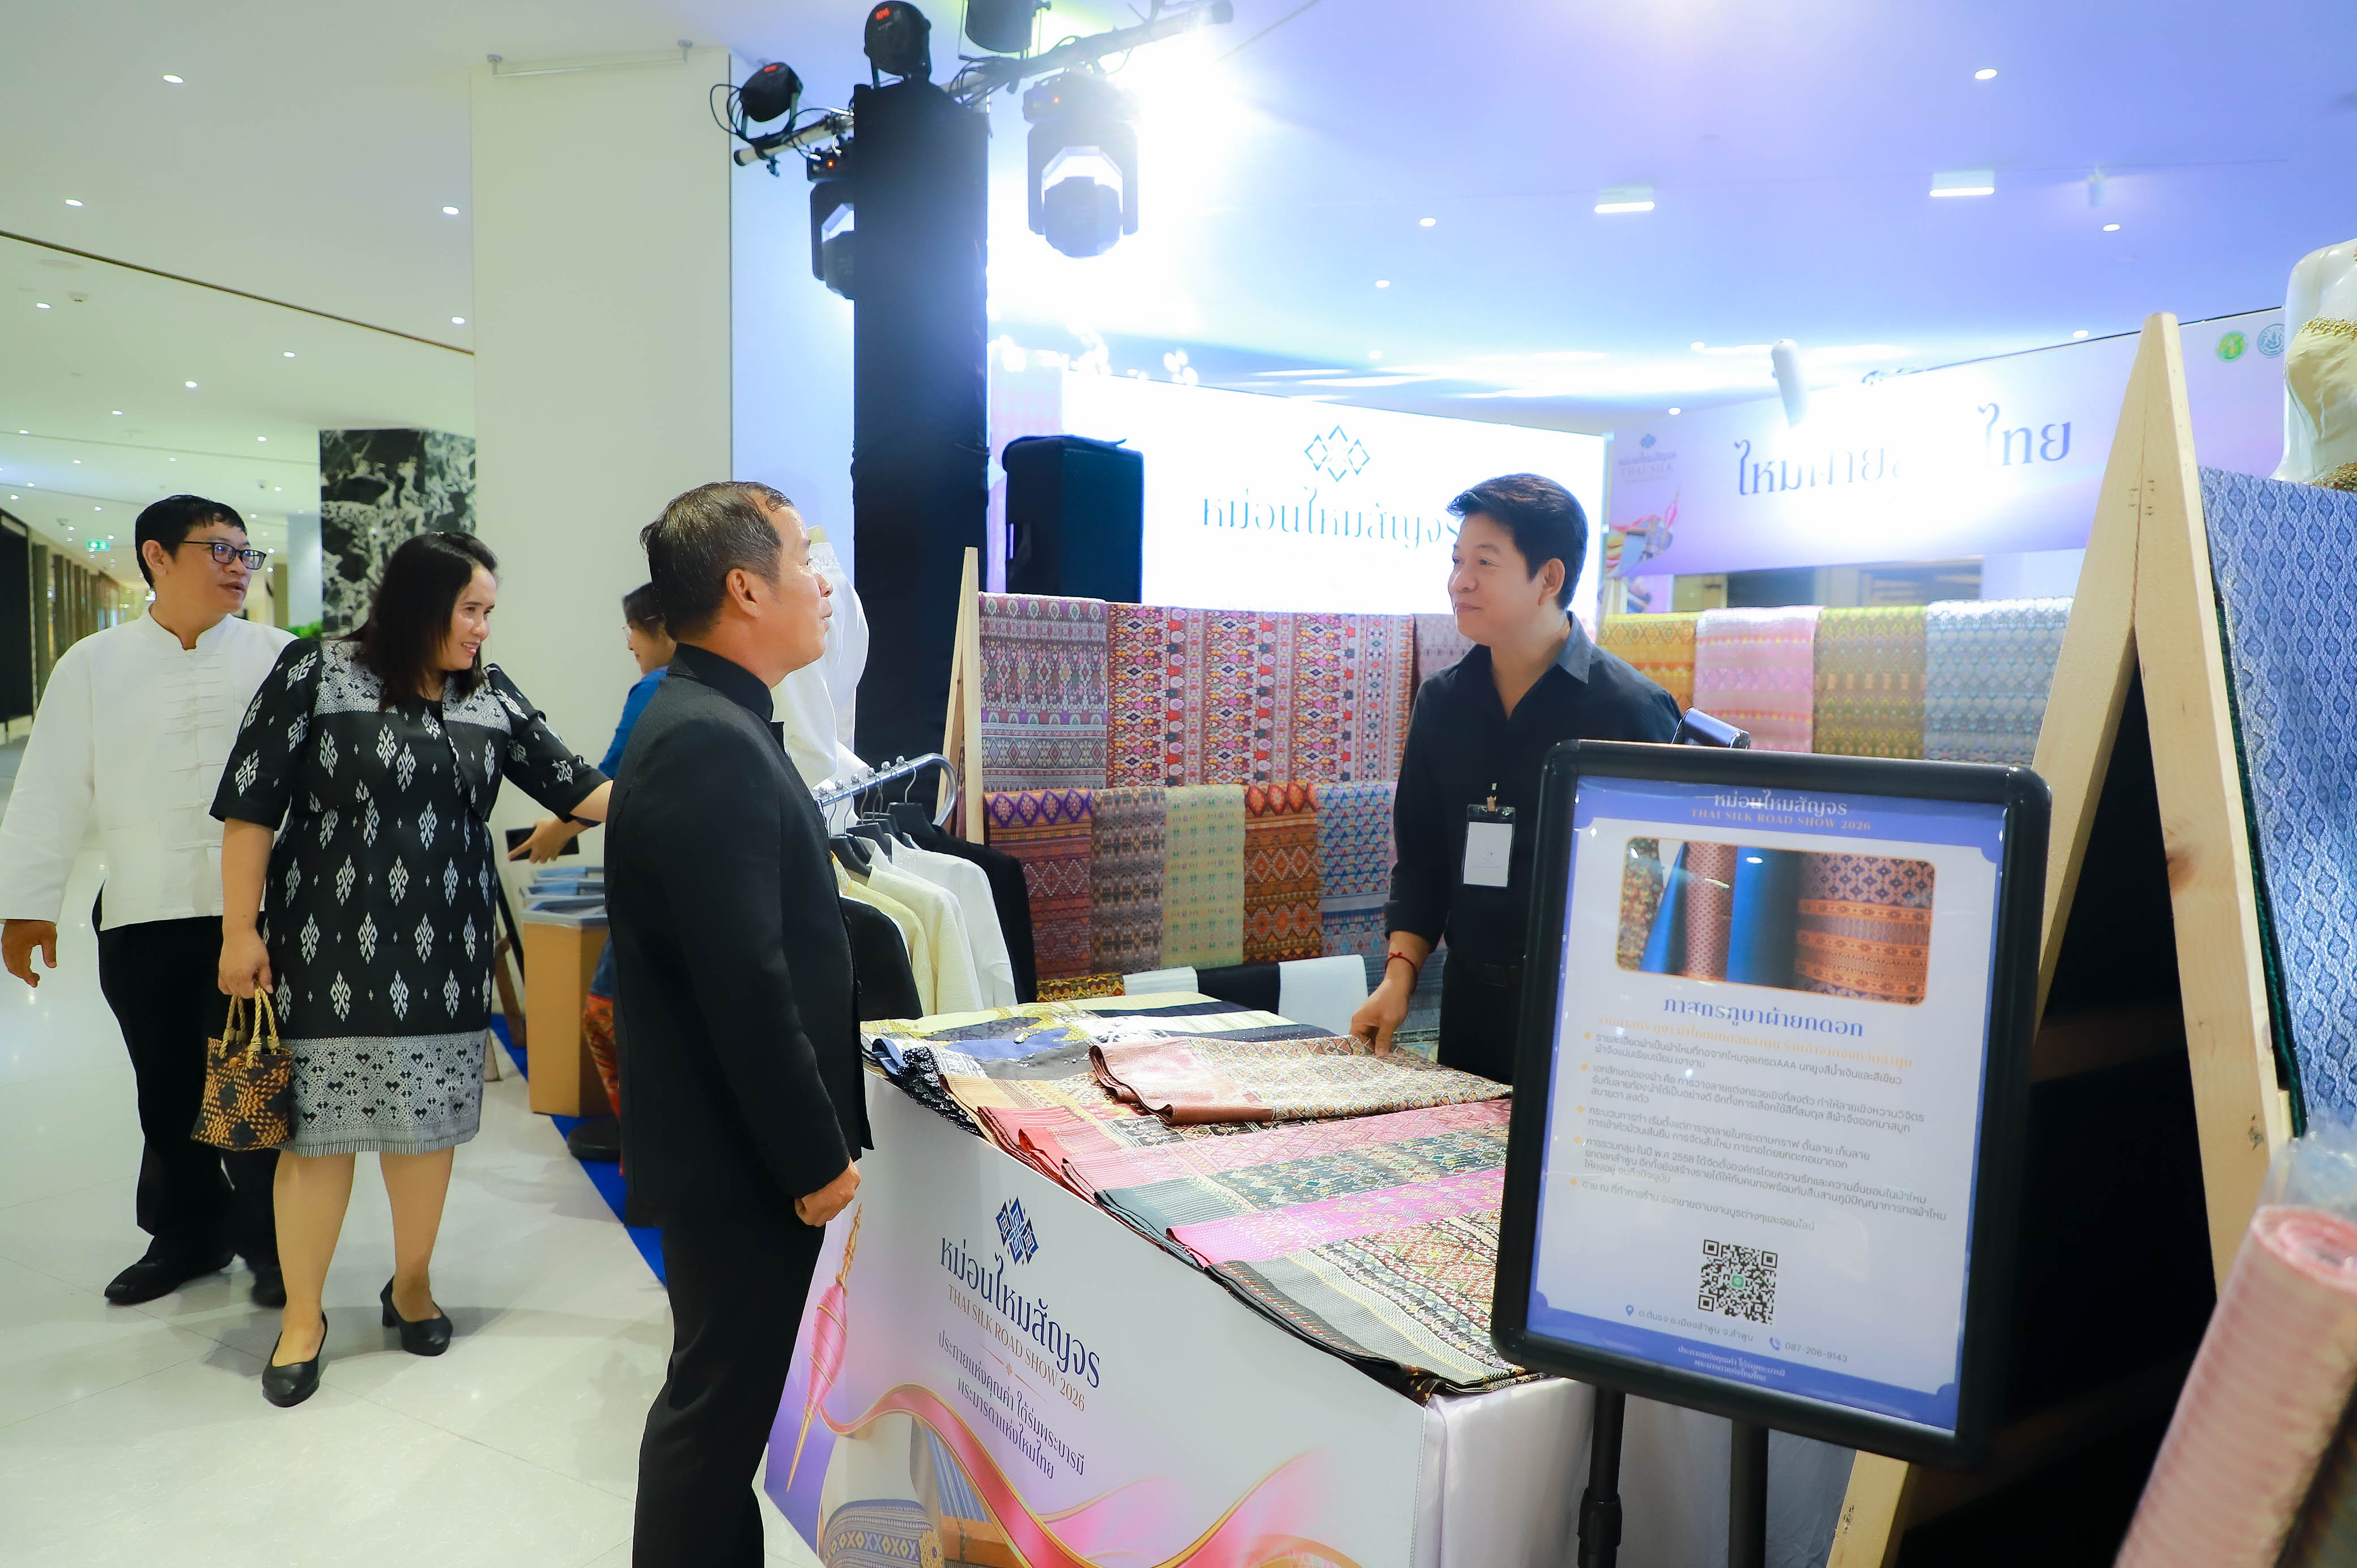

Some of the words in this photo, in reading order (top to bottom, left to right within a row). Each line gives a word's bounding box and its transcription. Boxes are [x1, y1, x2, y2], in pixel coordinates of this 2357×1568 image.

[1714, 789, 1848, 817] หม่อนไหมสัญจร
[1691, 808, 1721, 820] THAI
[1726, 811, 1752, 822] SILK
[1758, 813, 1793, 825] ROAD
[1797, 816, 1835, 828] SHOW
[1841, 820, 1871, 831] 2026
[1663, 998, 1864, 1037] ภาสกรภูษาผ้ายกดอก
[1593, 1064, 1662, 1081] เอกลักษณ์ของผ้า
[1663, 1072, 1676, 1084] คือ
[1675, 1057, 1705, 1068] เงางาม
[1591, 1087, 1624, 1099] สบายตา
[1626, 1091, 1649, 1104] ลงตัว
[1589, 1106, 1647, 1124] กระบวนการทำ
[1835, 1145, 1870, 1161] เก็บลาย
[1585, 1150, 1637, 1166] ยกดอกลำพูน
[1672, 1152, 1695, 1164] 2558
[940, 1237, 1100, 1388] หม่อนไหมสัญจร
[948, 1284, 971, 1315] THAI
[972, 1303, 993, 1335] SILK
[994, 1322, 1023, 1358] ROAD
[1024, 1348, 1058, 1387] SHOW
[1060, 1377, 1086, 1412] 2026
[939, 1330, 1014, 1412] ประกายแห่งคุณค่า
[1017, 1391, 1085, 1476] ใต้ร่มพระบารมี
[958, 1377, 1054, 1479] พระมารดาแห่งไหมไทย
